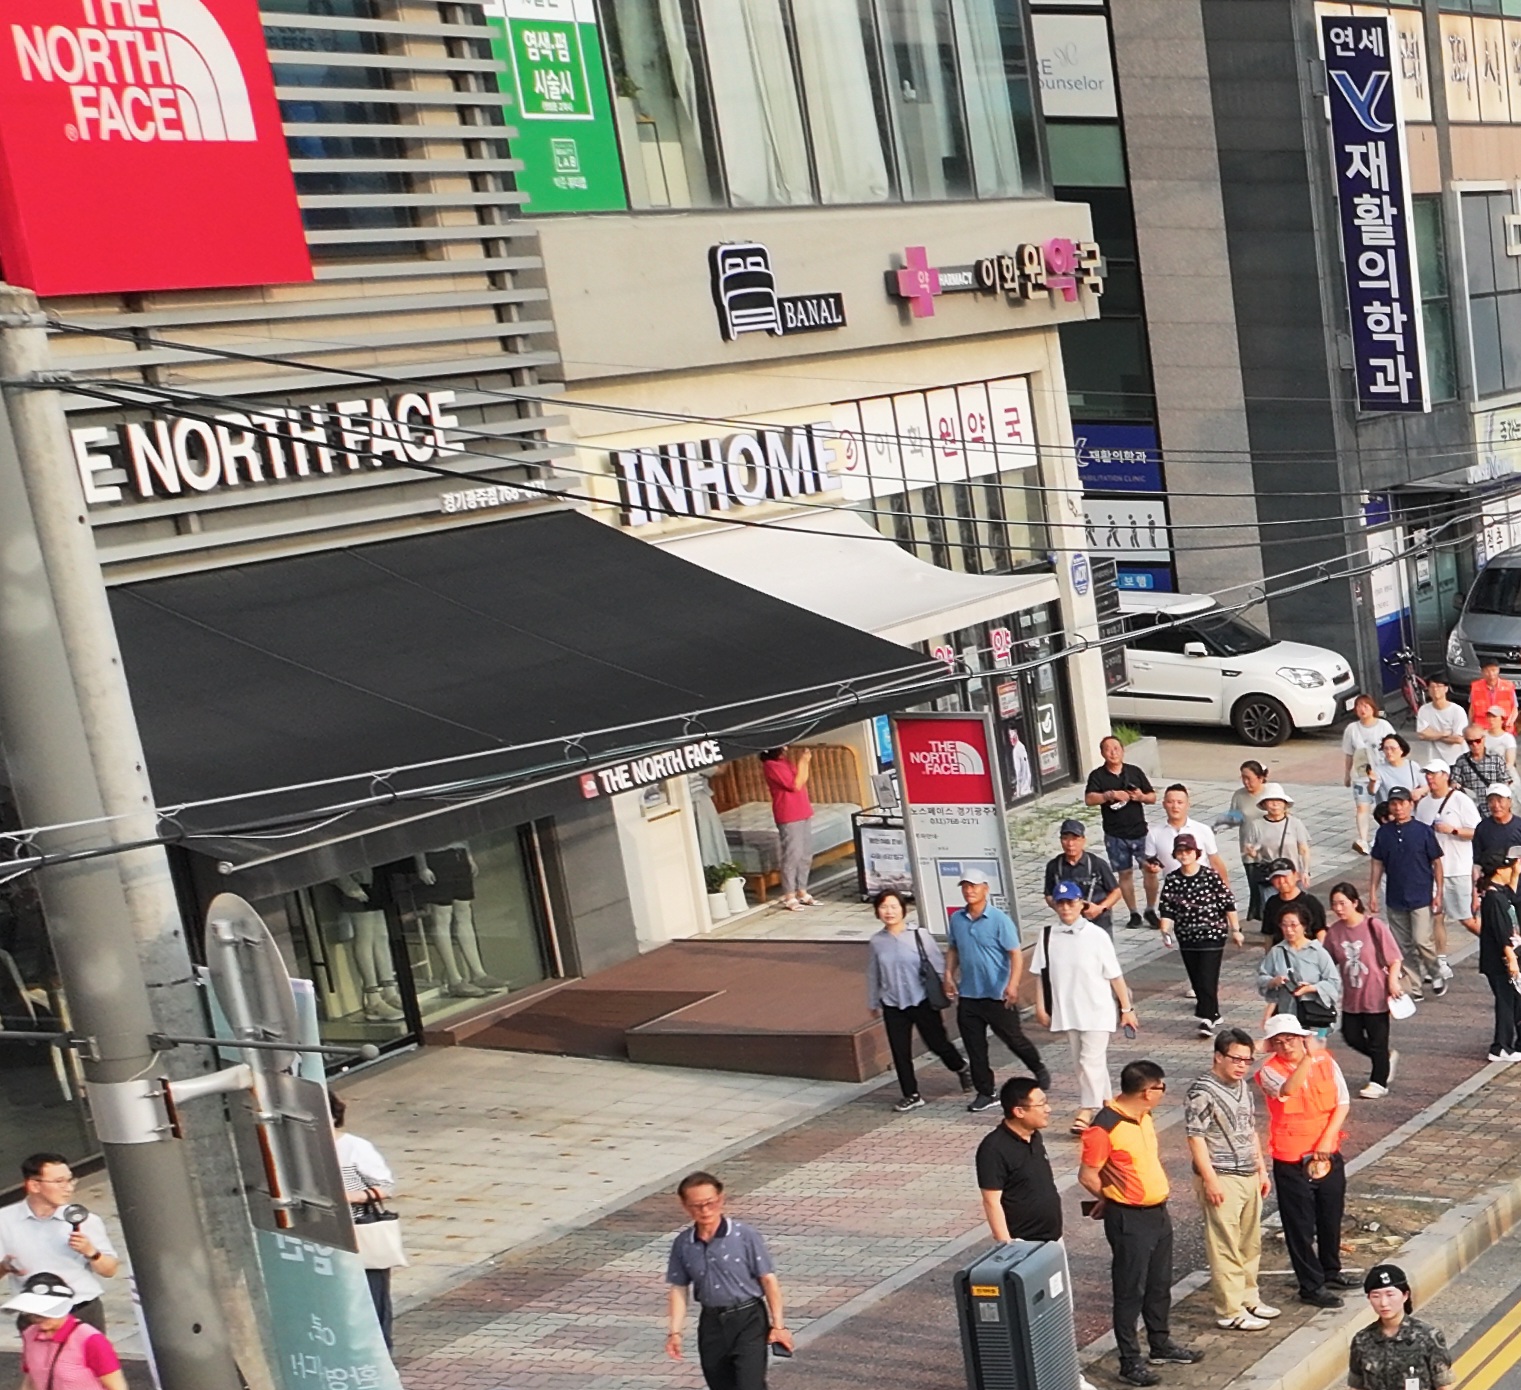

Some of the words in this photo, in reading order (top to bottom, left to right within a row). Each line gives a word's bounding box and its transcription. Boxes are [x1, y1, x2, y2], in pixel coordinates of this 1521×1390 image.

[10, 27, 173, 86] NORTH
[1329, 26, 1385, 58] 연세
[70, 87, 184, 143] FACE
[976, 237, 1104, 303] 이화원약국
[1344, 140, 1413, 404] 재활의학과
[784, 299, 843, 328] BANAL
[127, 403, 334, 499] NORTH
[336, 390, 465, 471] FACE
[874, 406, 1023, 464] 이화원약국
[1088, 449, 1148, 465] 재활의학과
[613, 420, 842, 527] INHOME
[597, 765, 632, 795] THE
[632, 748, 686, 786] NORTH
[683, 737, 725, 771] FACE
[909, 751, 958, 764] NORTH
[924, 763, 961, 775] FACE
[928, 740, 957, 752] THE
